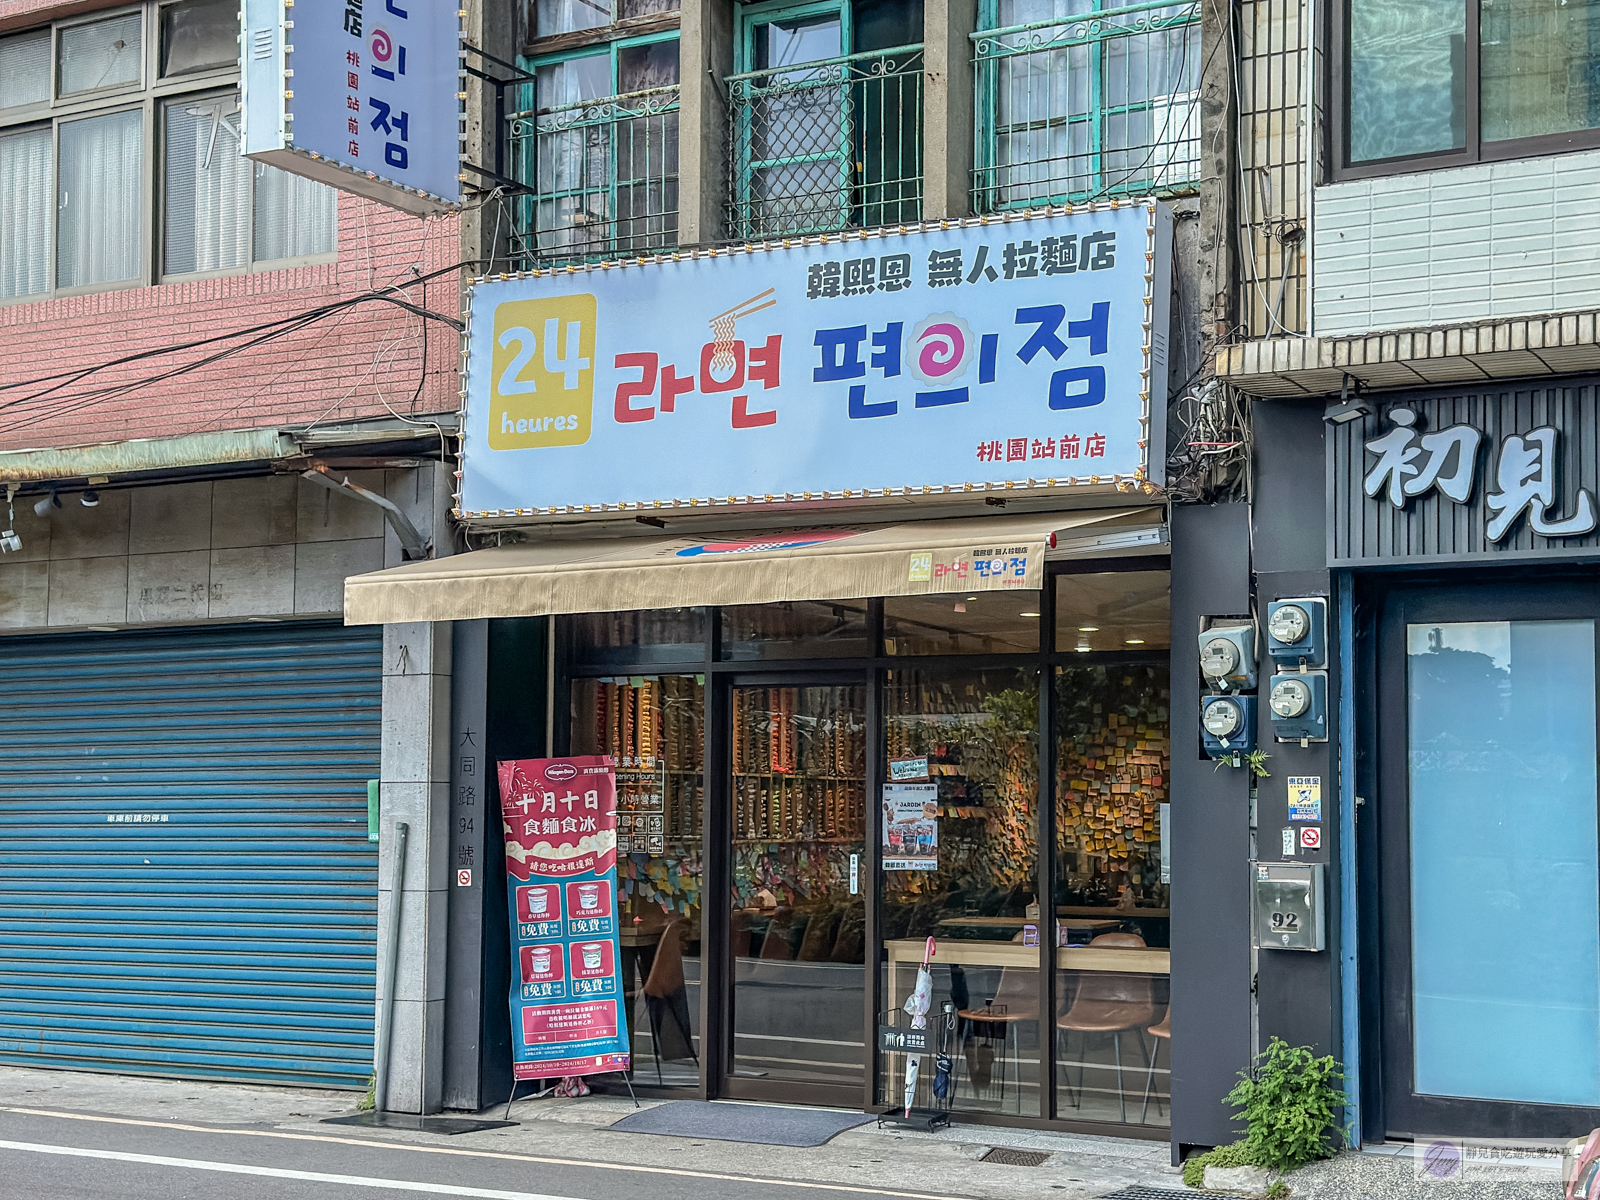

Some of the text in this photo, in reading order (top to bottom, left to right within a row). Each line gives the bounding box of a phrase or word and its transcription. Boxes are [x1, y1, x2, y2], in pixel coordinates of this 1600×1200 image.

[346, 50, 360, 158] 桃園站前店
[806, 230, 1117, 300] 韓熙恩 無人拉麵店
[495, 316, 591, 398] 24
[613, 300, 1112, 429] 라면 편의점
[500, 411, 579, 435] heures
[976, 432, 1107, 464] 桃園站前店
[1362, 406, 1598, 543] 初見
[911, 556, 930, 572] 24
[973, 557, 1027, 578] 편의점
[457, 726, 477, 867] 大同路94號
[515, 789, 599, 815] 十月十日
[106, 814, 170, 823] 車庫前請勿停車
[522, 815, 598, 836] 食麵食冰
[526, 922, 550, 937] 免費
[577, 919, 600, 933] 免費
[1272, 912, 1298, 927] 92
[529, 982, 553, 997] 免費
[580, 978, 603, 993] 免費
